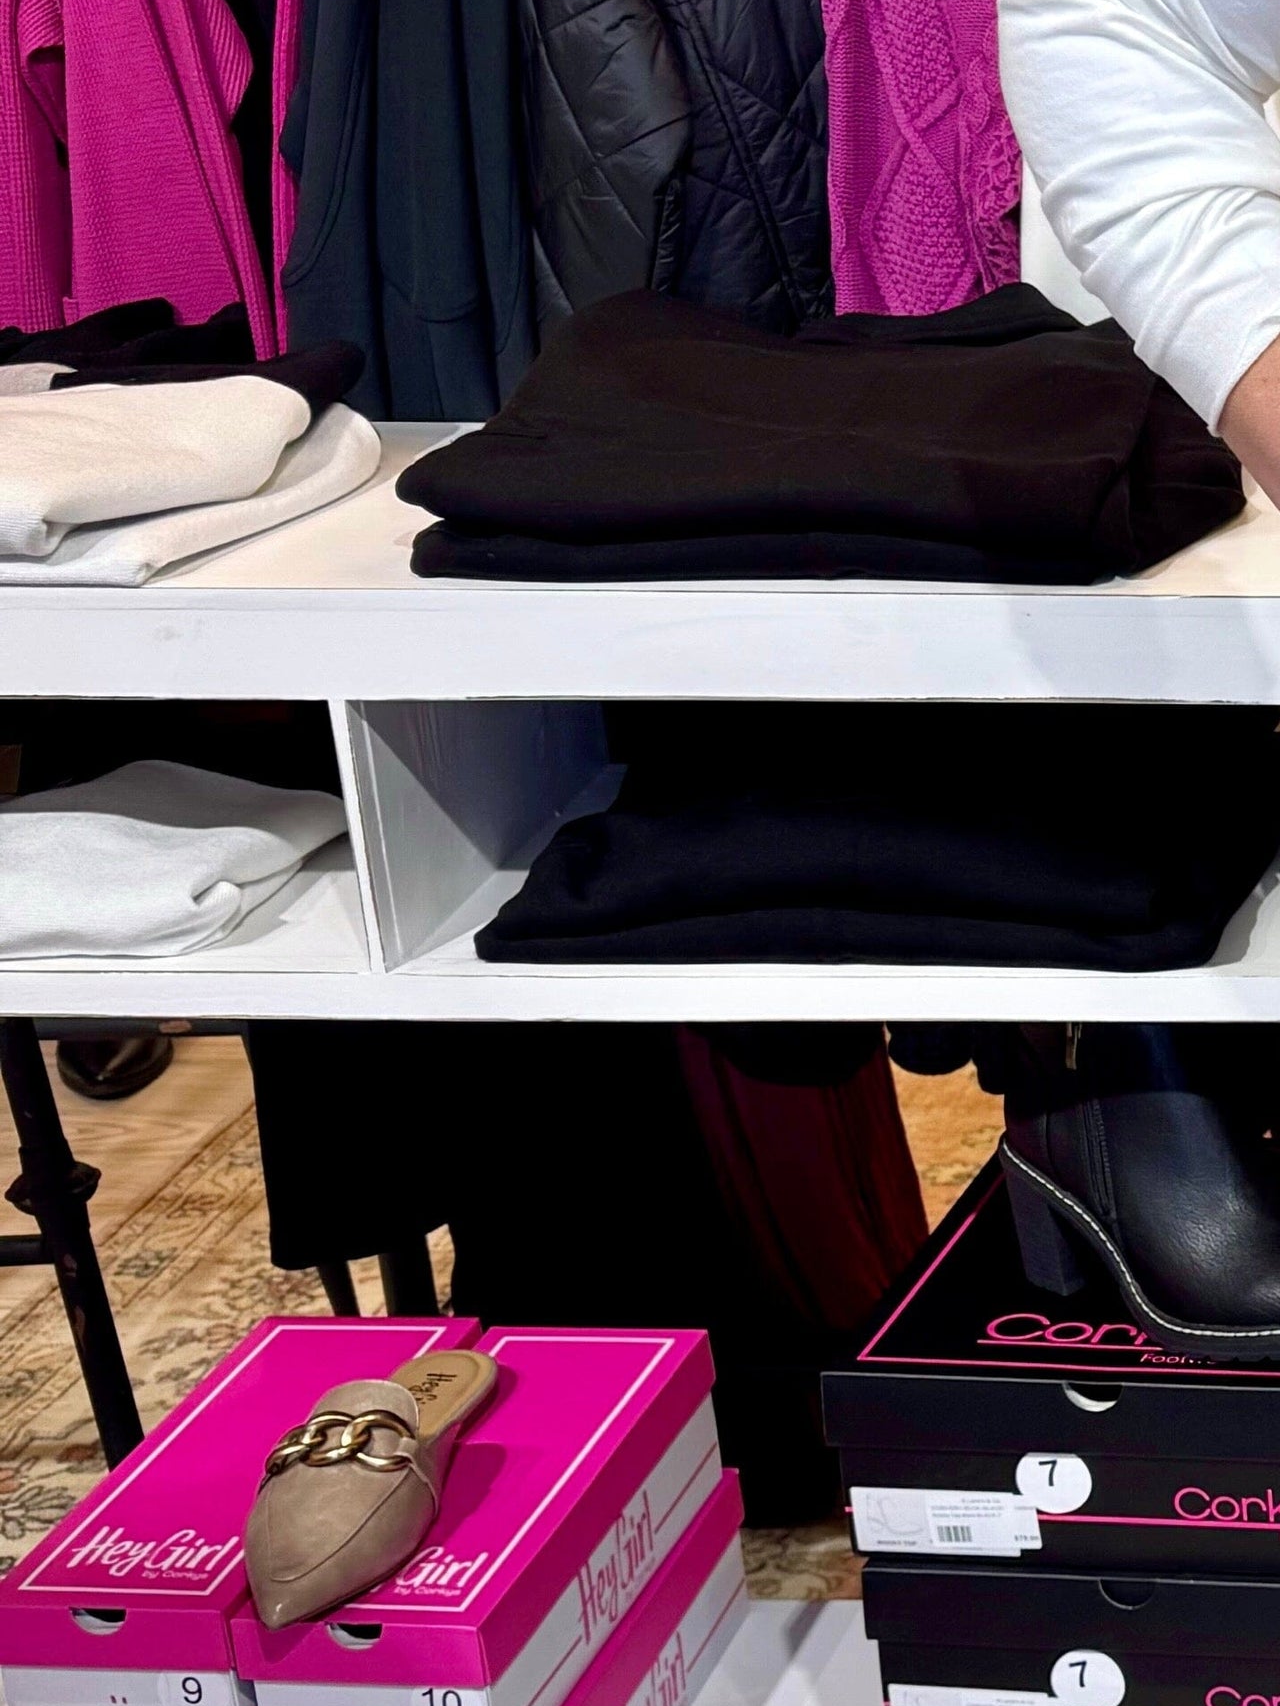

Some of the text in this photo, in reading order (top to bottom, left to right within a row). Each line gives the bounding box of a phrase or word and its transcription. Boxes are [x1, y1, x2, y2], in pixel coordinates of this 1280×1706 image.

[986, 1313, 1148, 1345] Cor
[1038, 1459, 1058, 1487] 7
[1068, 1660, 1087, 1688] 7
[181, 1676, 203, 1704] 9
